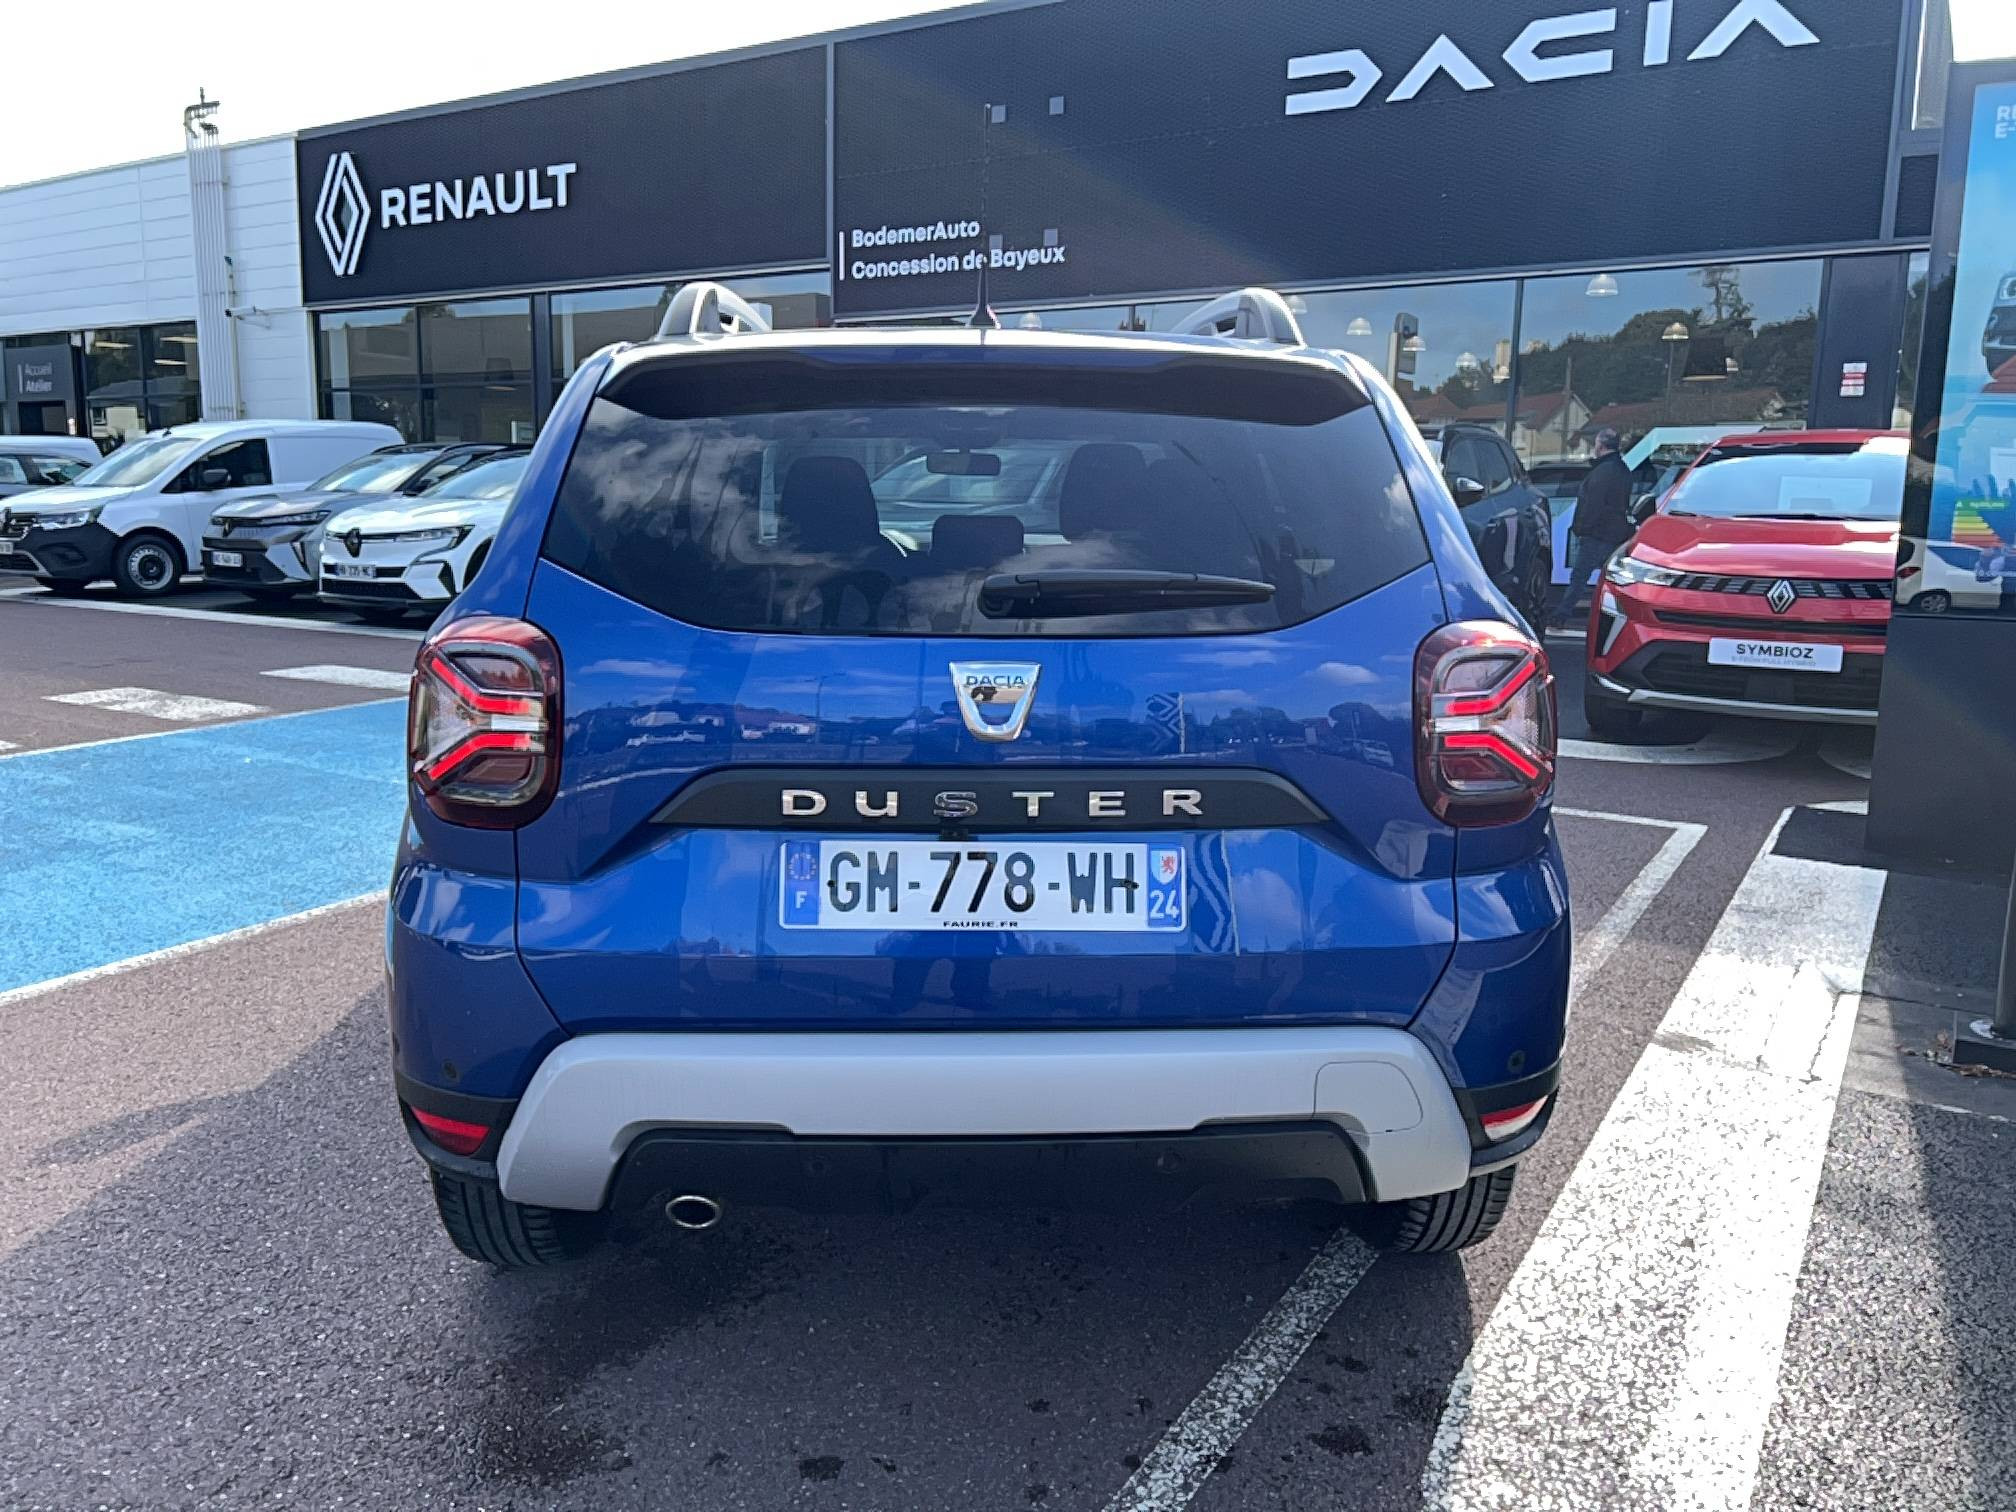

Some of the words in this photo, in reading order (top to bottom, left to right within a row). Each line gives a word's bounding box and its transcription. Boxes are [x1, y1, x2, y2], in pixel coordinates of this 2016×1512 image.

[1284, 0, 1821, 116] DACIA
[380, 162, 578, 230] RENAULT
[851, 220, 981, 248] BodemerAuto
[851, 253, 960, 280] Concession
[962, 249, 987, 271] de
[989, 245, 1066, 271] Bayeux
[1736, 643, 1815, 659] SYMBIOZ
[965, 675, 1025, 687] DACIA
[781, 788, 1204, 818] DUSTER
[829, 850, 1136, 914] GM-778-WH
[795, 890, 808, 909] F
[1149, 889, 1180, 920] 24
[942, 919, 1019, 928] FAURIE.FR
